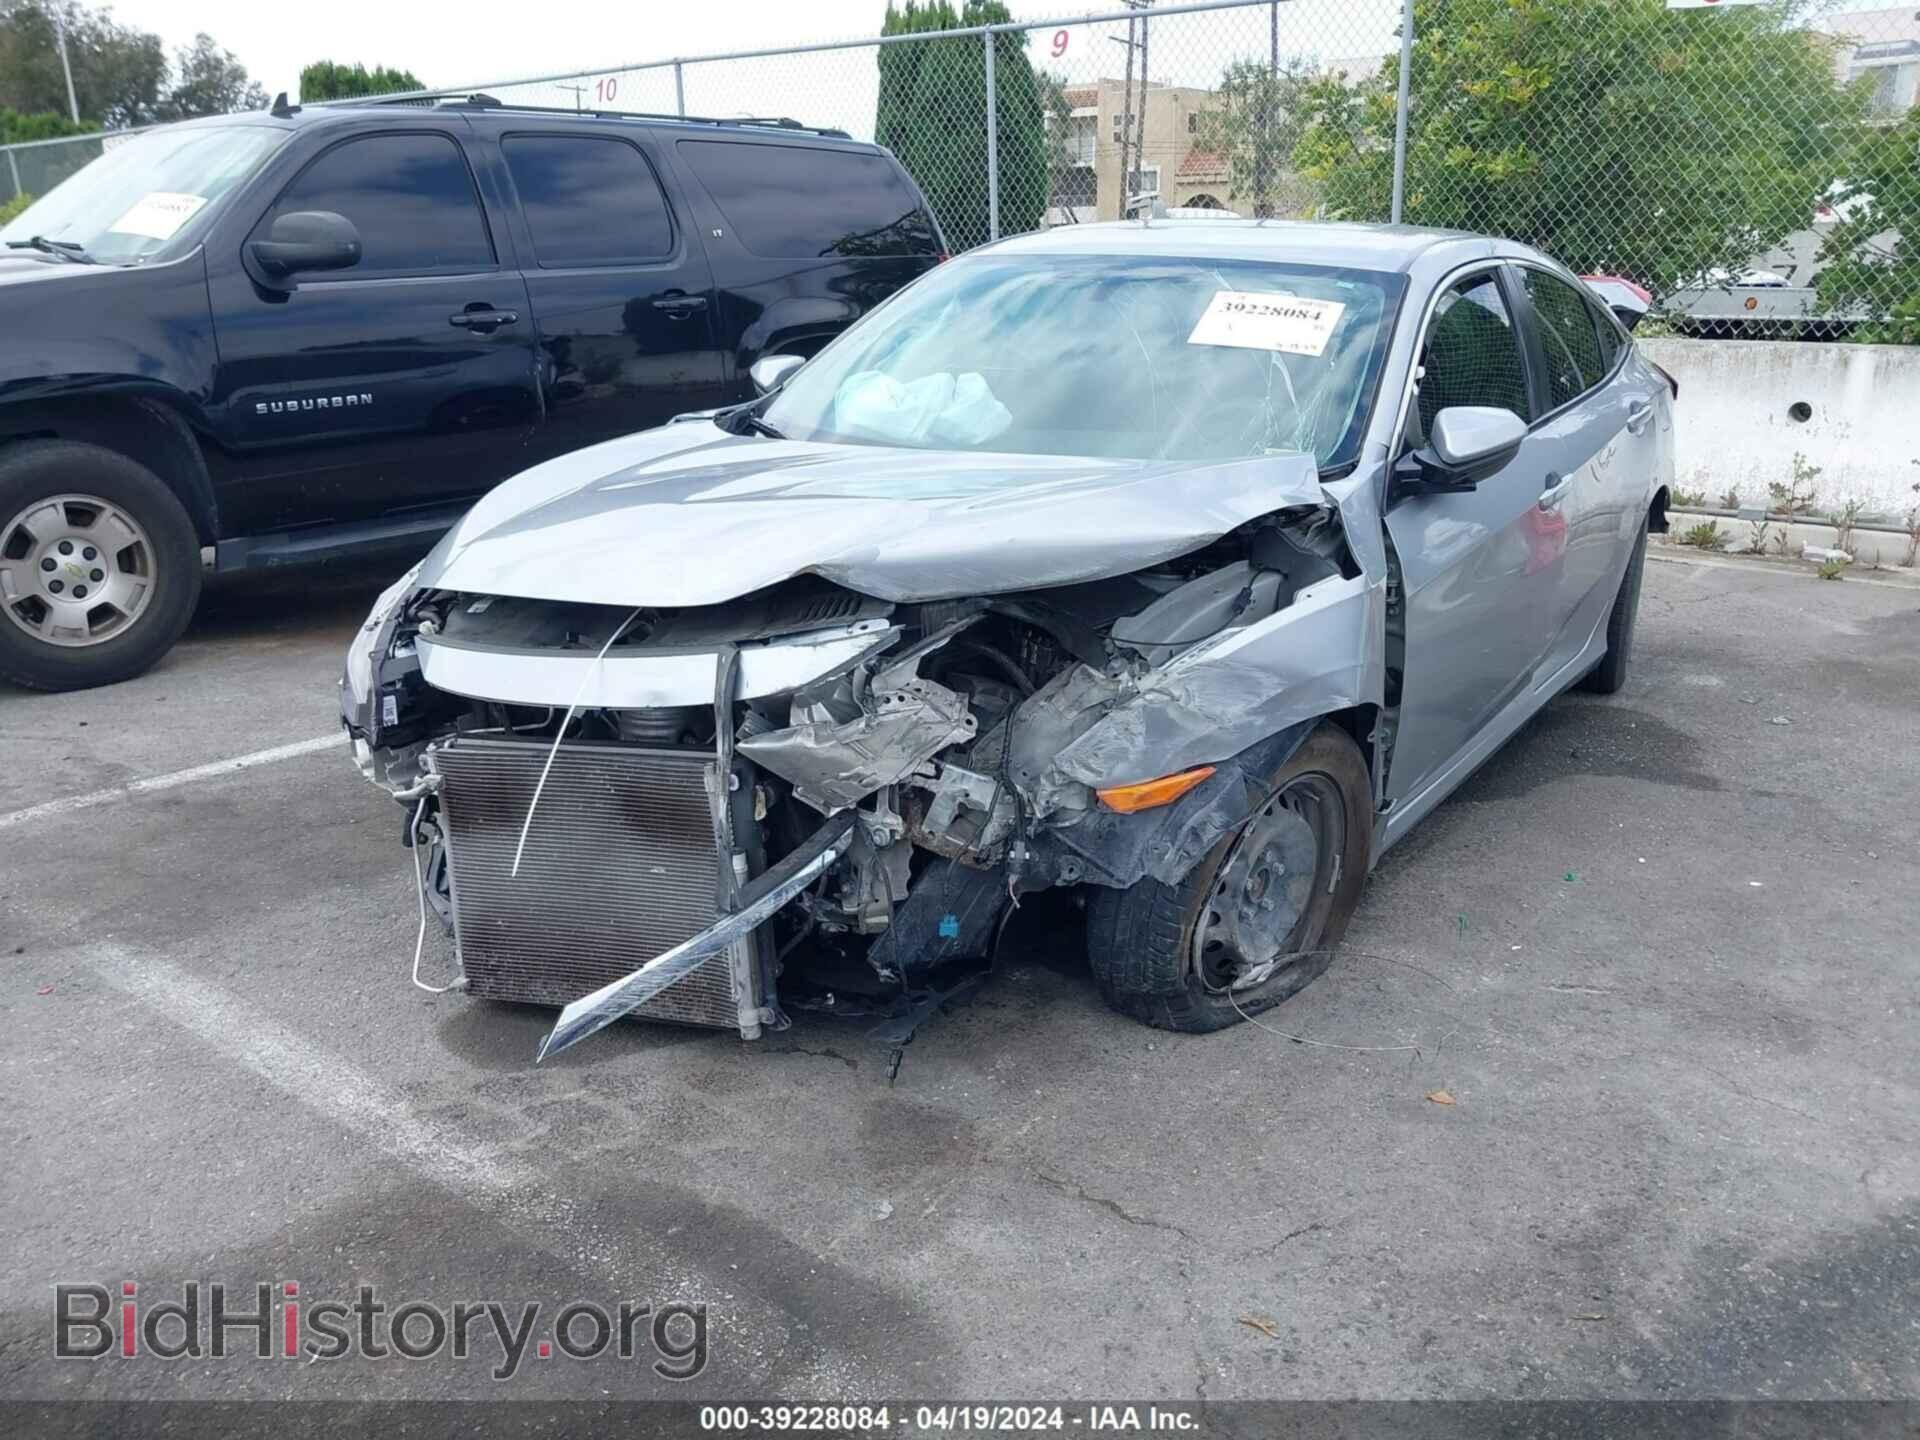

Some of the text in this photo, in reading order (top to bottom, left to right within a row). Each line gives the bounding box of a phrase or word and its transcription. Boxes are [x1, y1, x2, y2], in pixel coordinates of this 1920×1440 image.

[1051, 30, 1069, 58] 9
[595, 78, 617, 103] 10
[1218, 301, 1322, 321] 39228084
[255, 393, 373, 415] SUBURBAN
